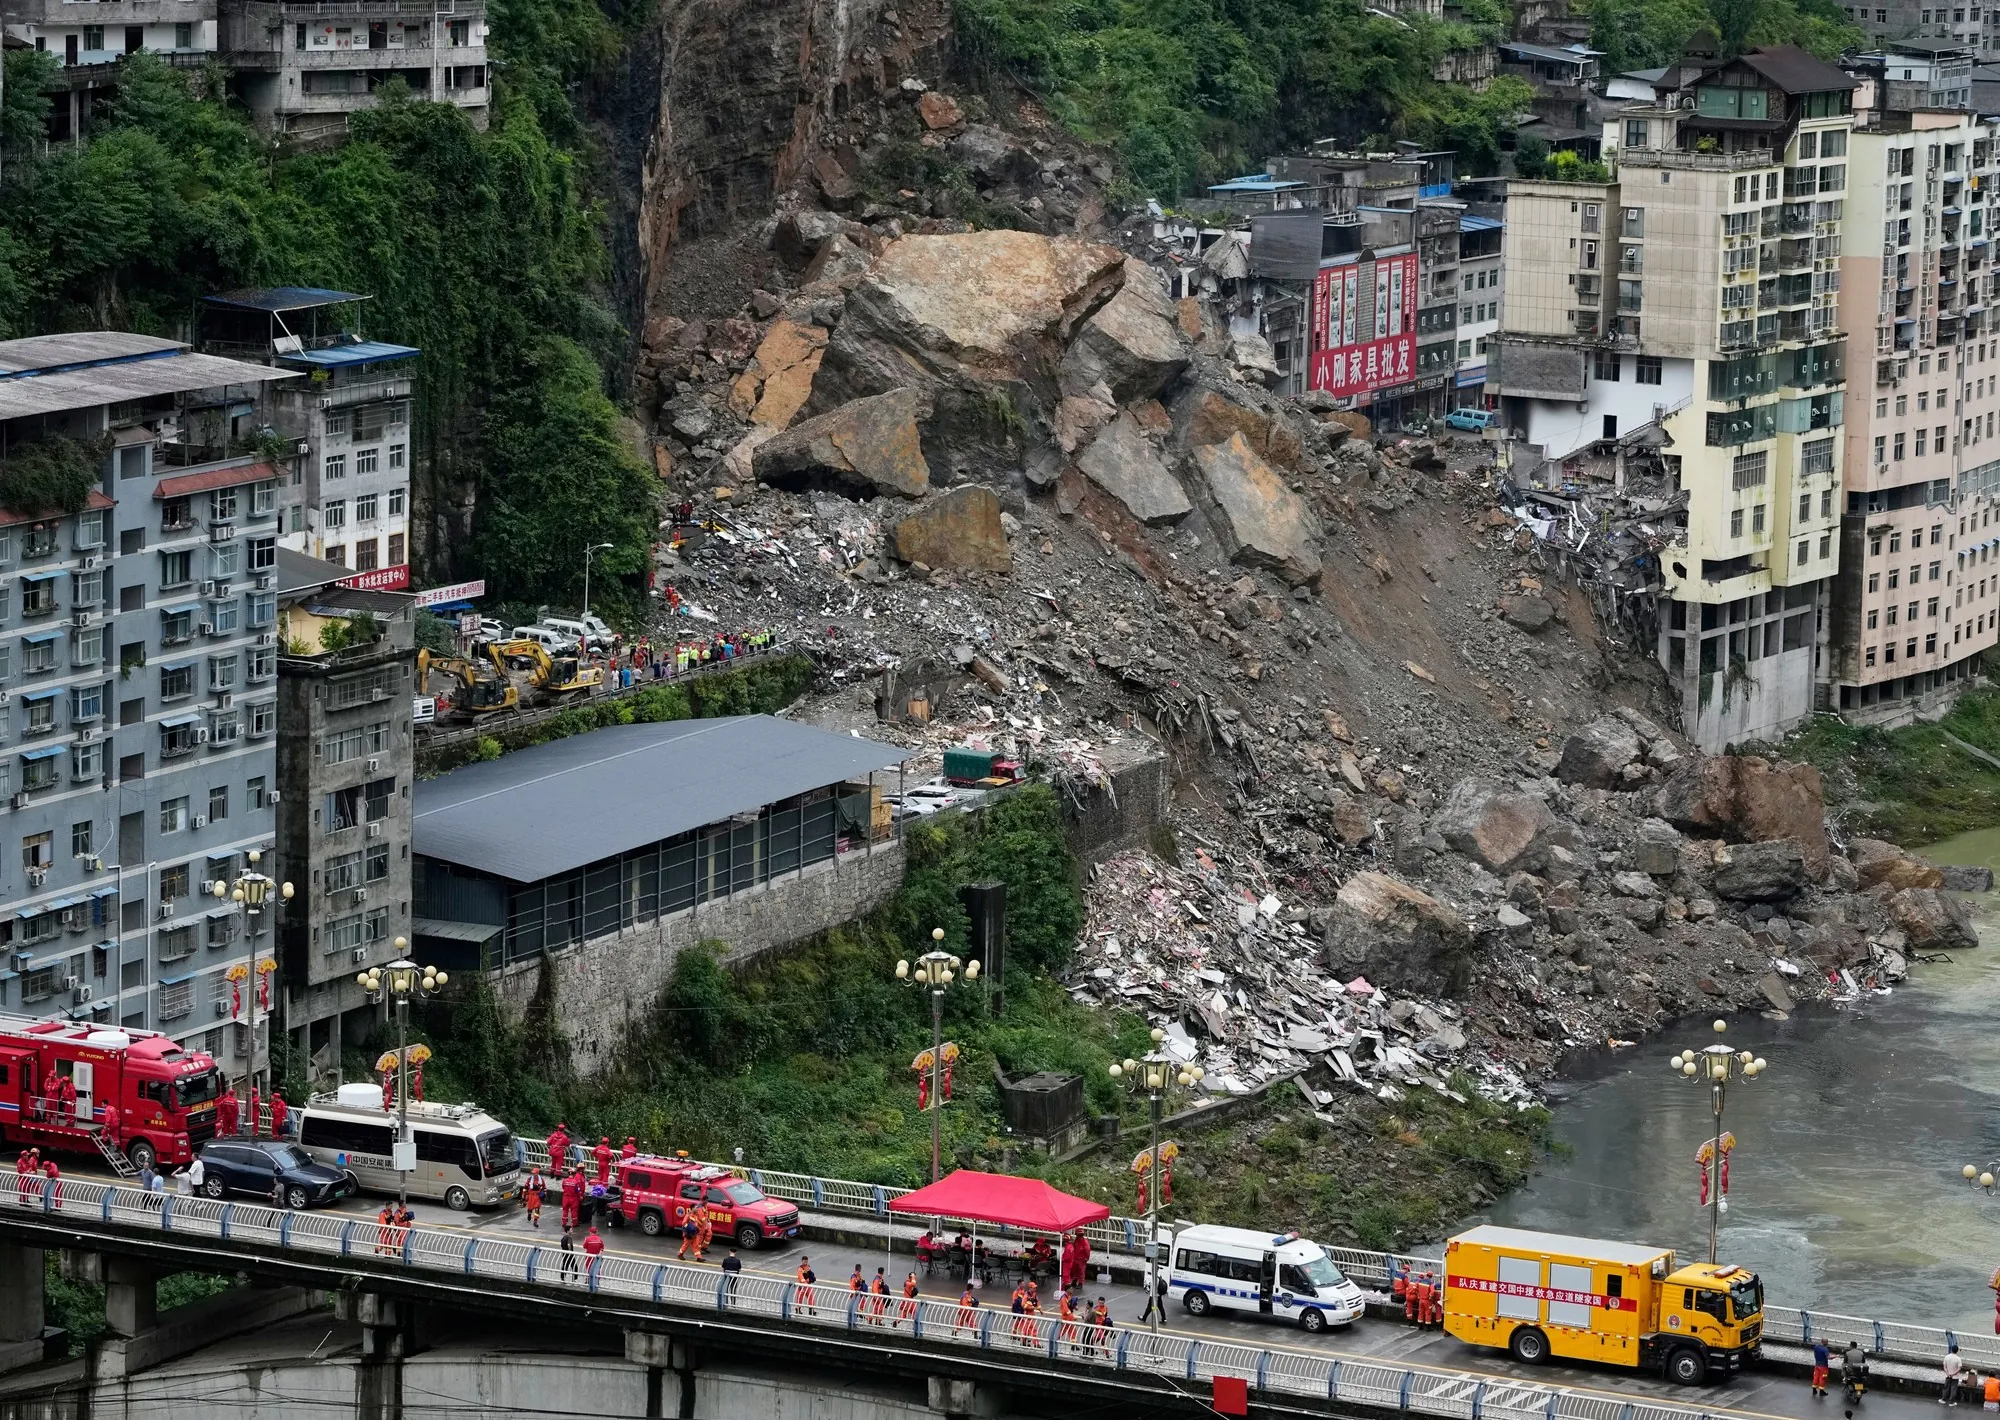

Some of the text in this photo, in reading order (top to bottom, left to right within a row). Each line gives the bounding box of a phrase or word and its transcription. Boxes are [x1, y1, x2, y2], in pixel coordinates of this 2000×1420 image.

[1316, 339, 1410, 390] 小刚家具批发
[359, 569, 405, 589] 彭水批发运营中心
[353, 1155, 394, 1168] 中国安能集
